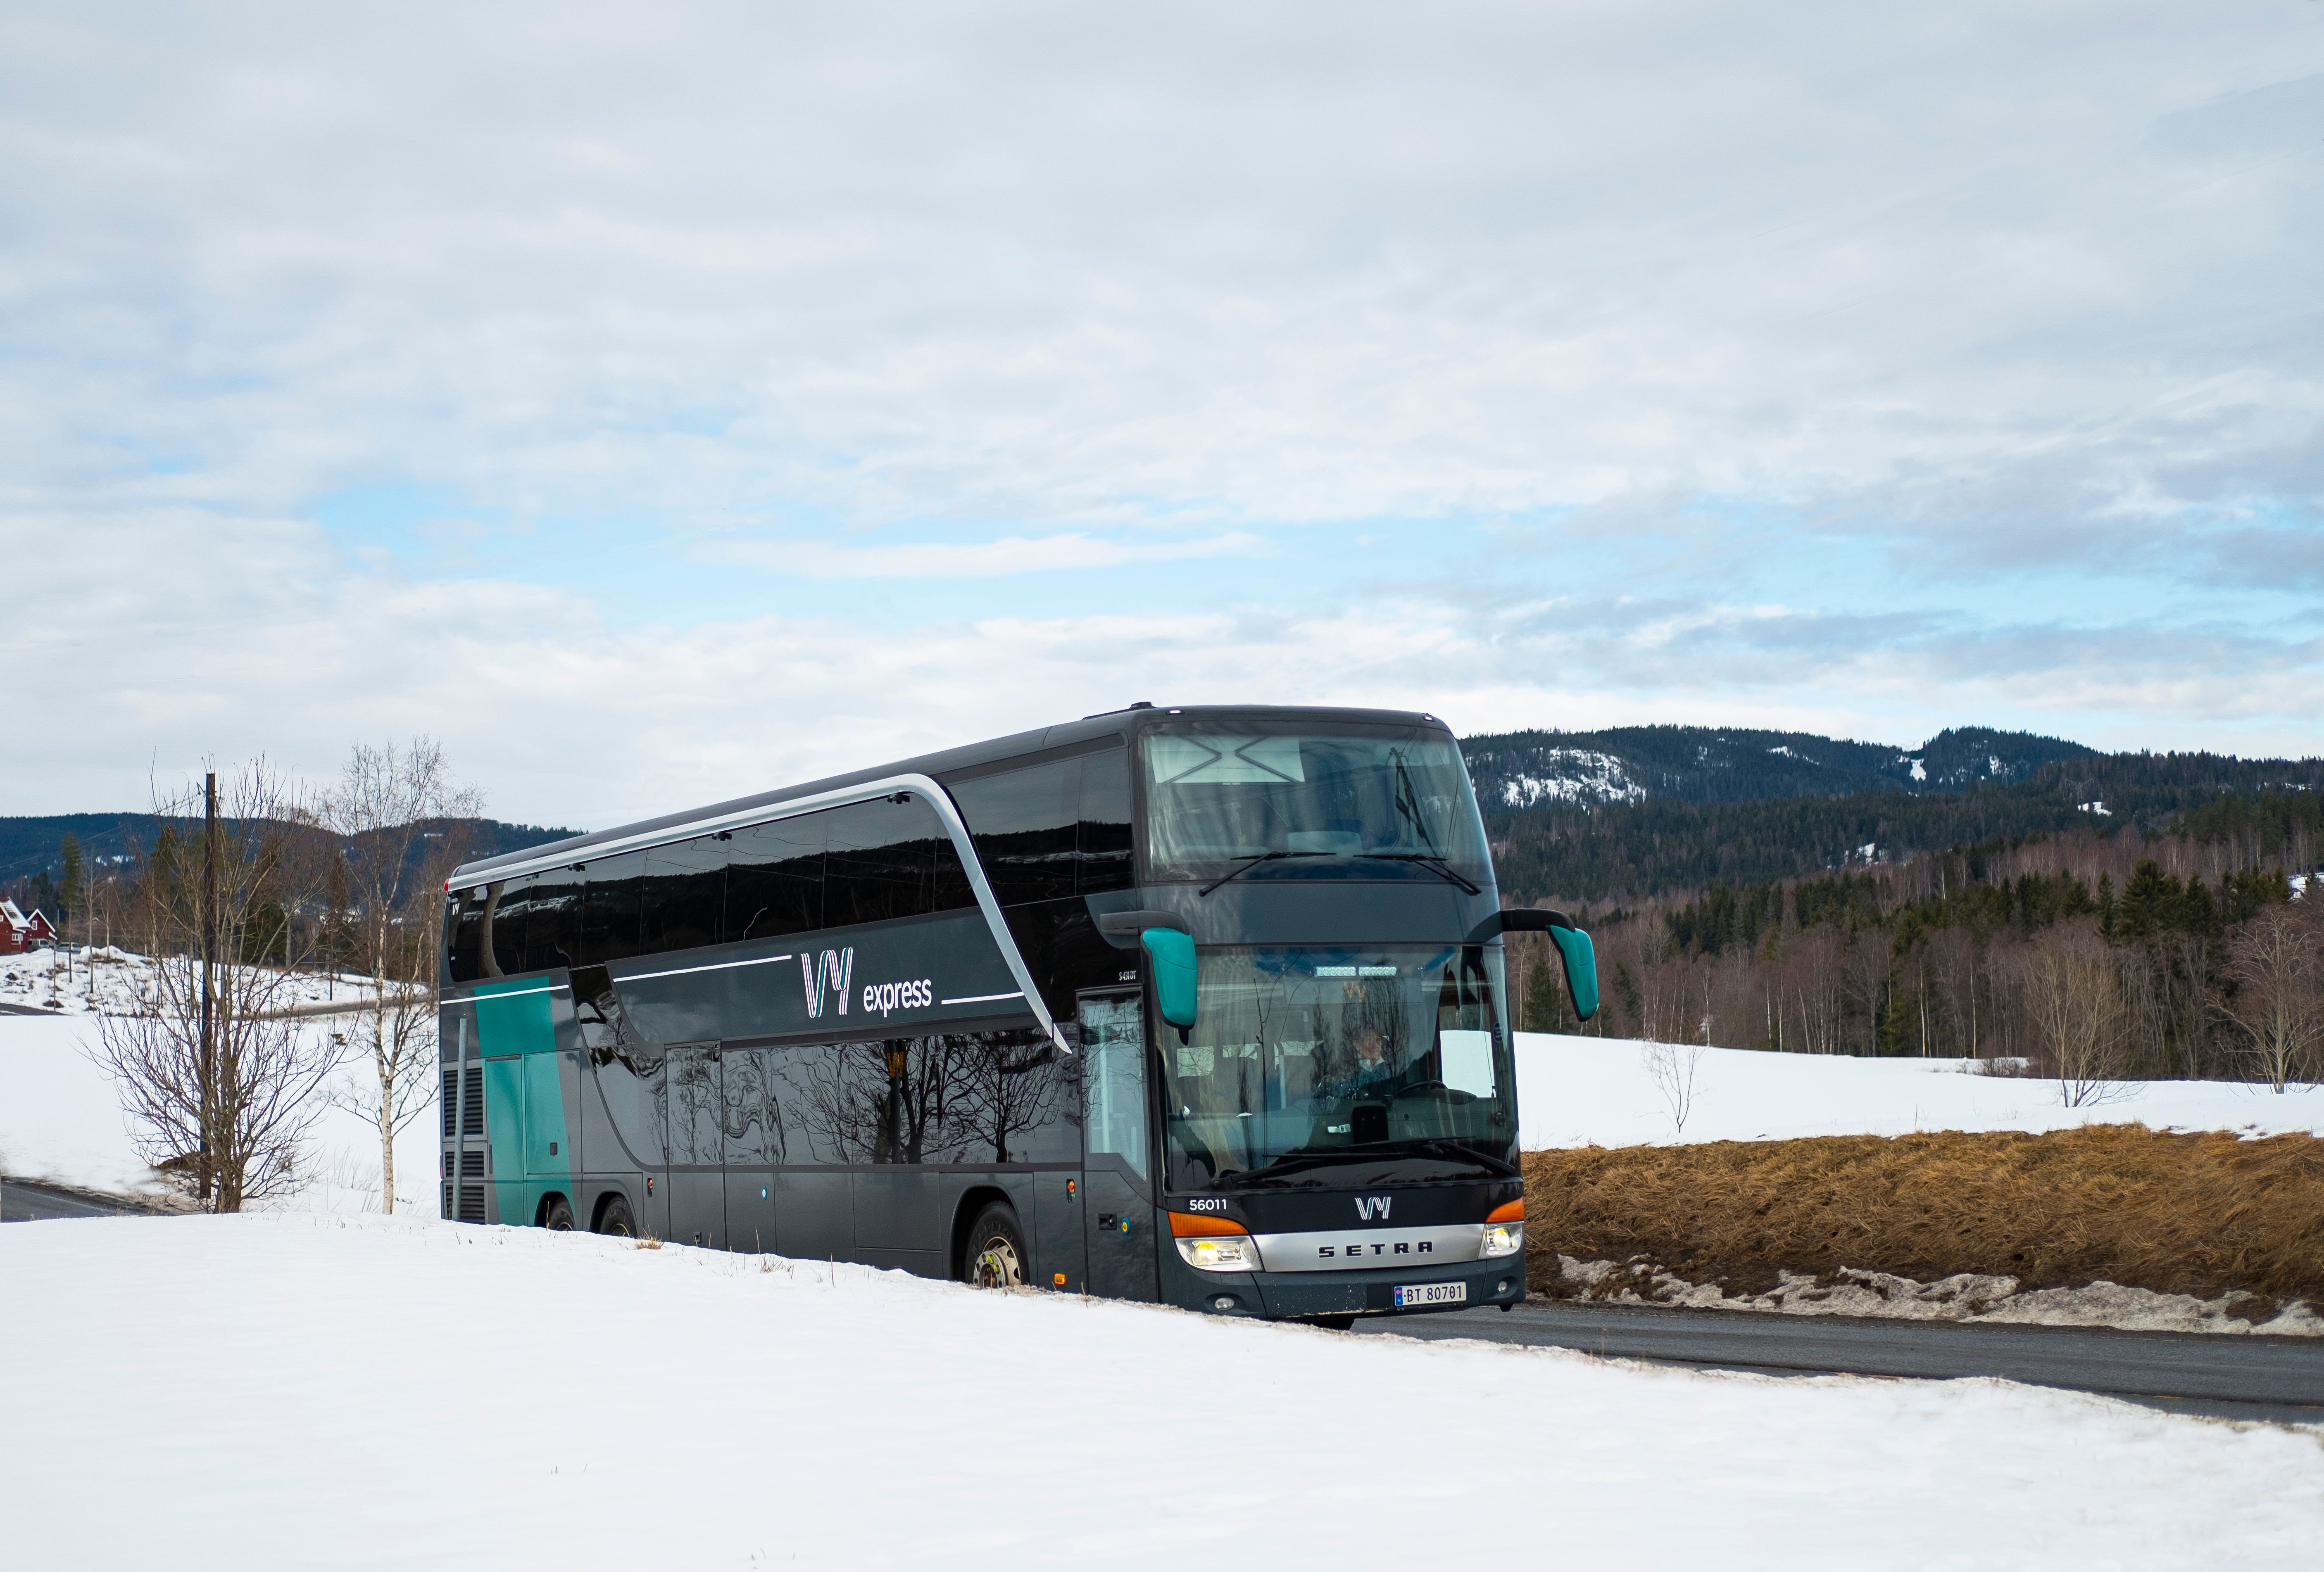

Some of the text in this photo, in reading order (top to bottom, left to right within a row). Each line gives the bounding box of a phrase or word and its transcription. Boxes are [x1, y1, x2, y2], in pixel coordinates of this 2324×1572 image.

[801, 947, 932, 1018] VY express
[1118, 971, 1122, 981] S
[1130, 970, 1136, 980] DT
[1189, 1199, 1227, 1211] 56011
[1355, 1196, 1392, 1221] VY
[1318, 1241, 1433, 1259] SETRA
[1407, 1285, 1462, 1302] BT 80701
